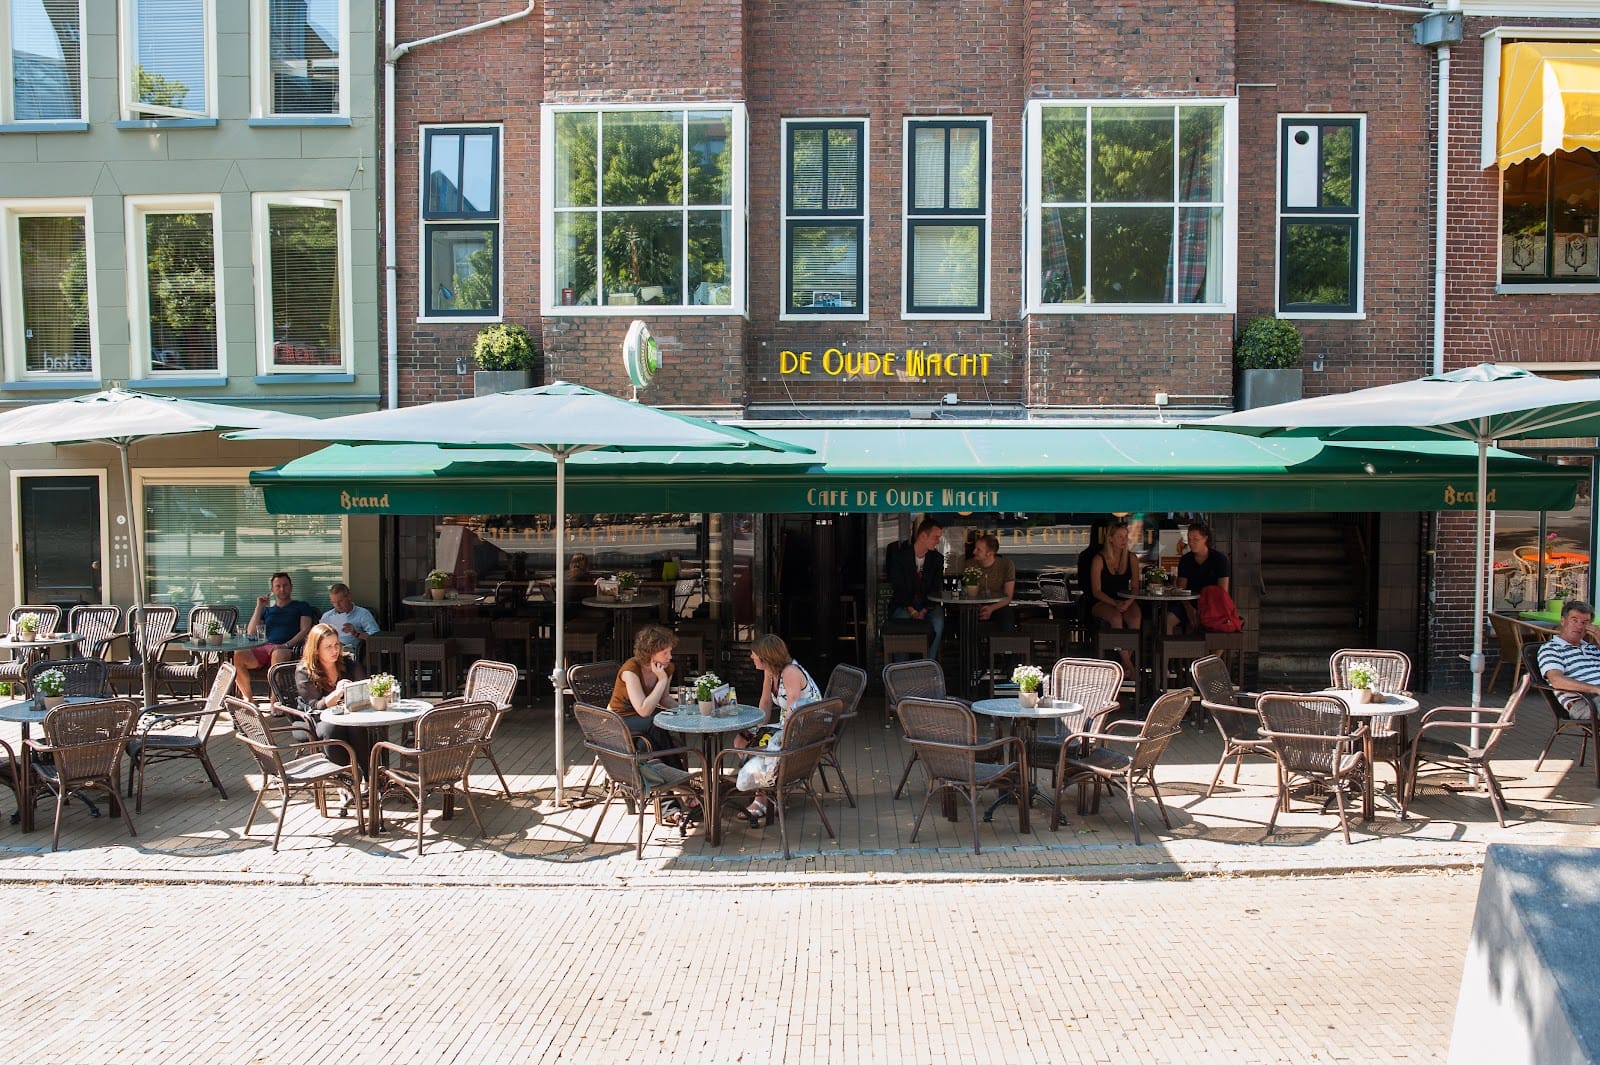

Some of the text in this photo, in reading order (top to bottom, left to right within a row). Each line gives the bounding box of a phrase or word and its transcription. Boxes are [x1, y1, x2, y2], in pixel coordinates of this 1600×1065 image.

[780, 348, 993, 377] DE OUDE WACHT
[340, 490, 390, 510] Brand
[856, 490, 878, 507] DE
[885, 488, 934, 507] OUDE
[941, 488, 1000, 507] WACHT
